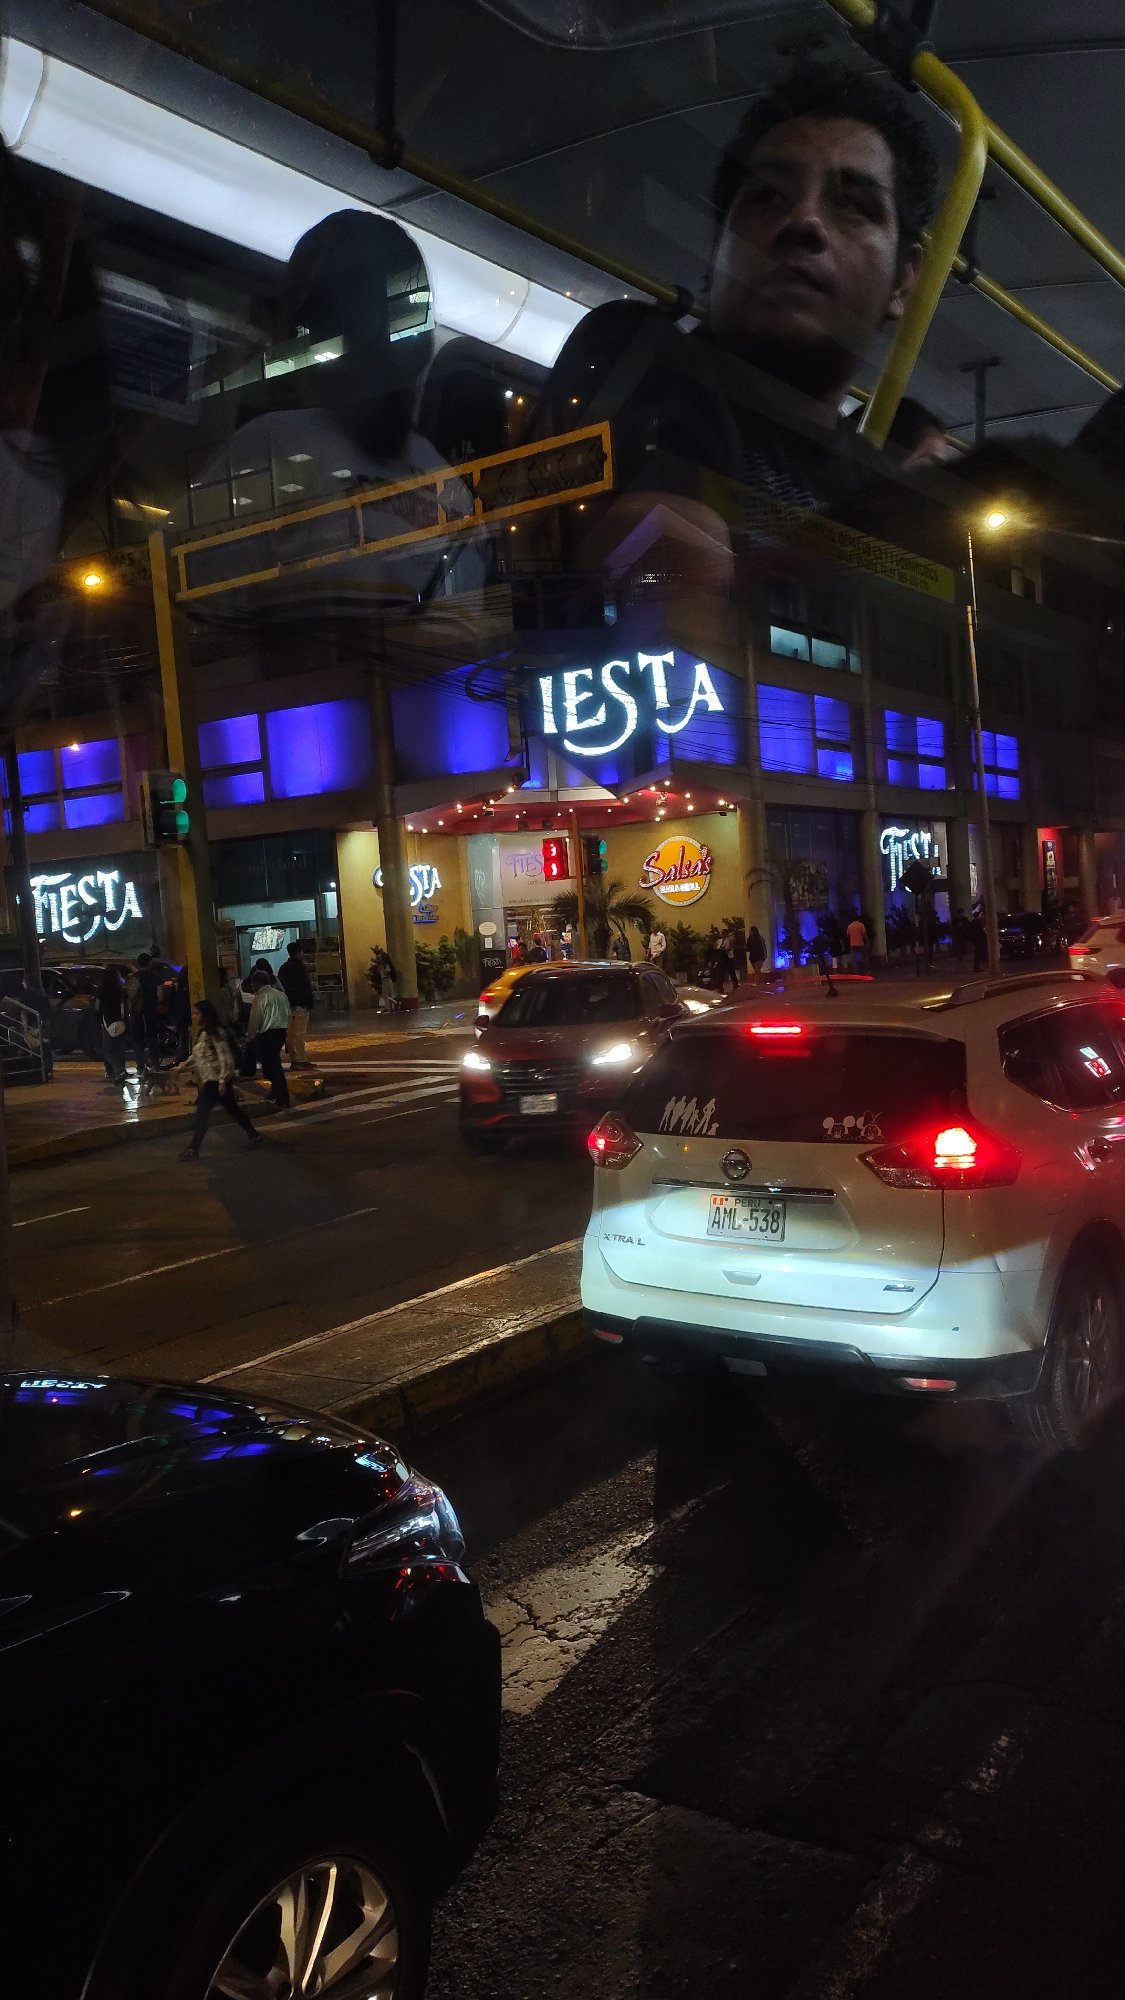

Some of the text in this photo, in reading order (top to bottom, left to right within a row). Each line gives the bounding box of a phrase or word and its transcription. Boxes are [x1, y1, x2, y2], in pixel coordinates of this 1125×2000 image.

[16, 869, 143, 943] FIESTA
[734, 1197, 761, 1208] PERU
[711, 1206, 781, 1234] AML-538
